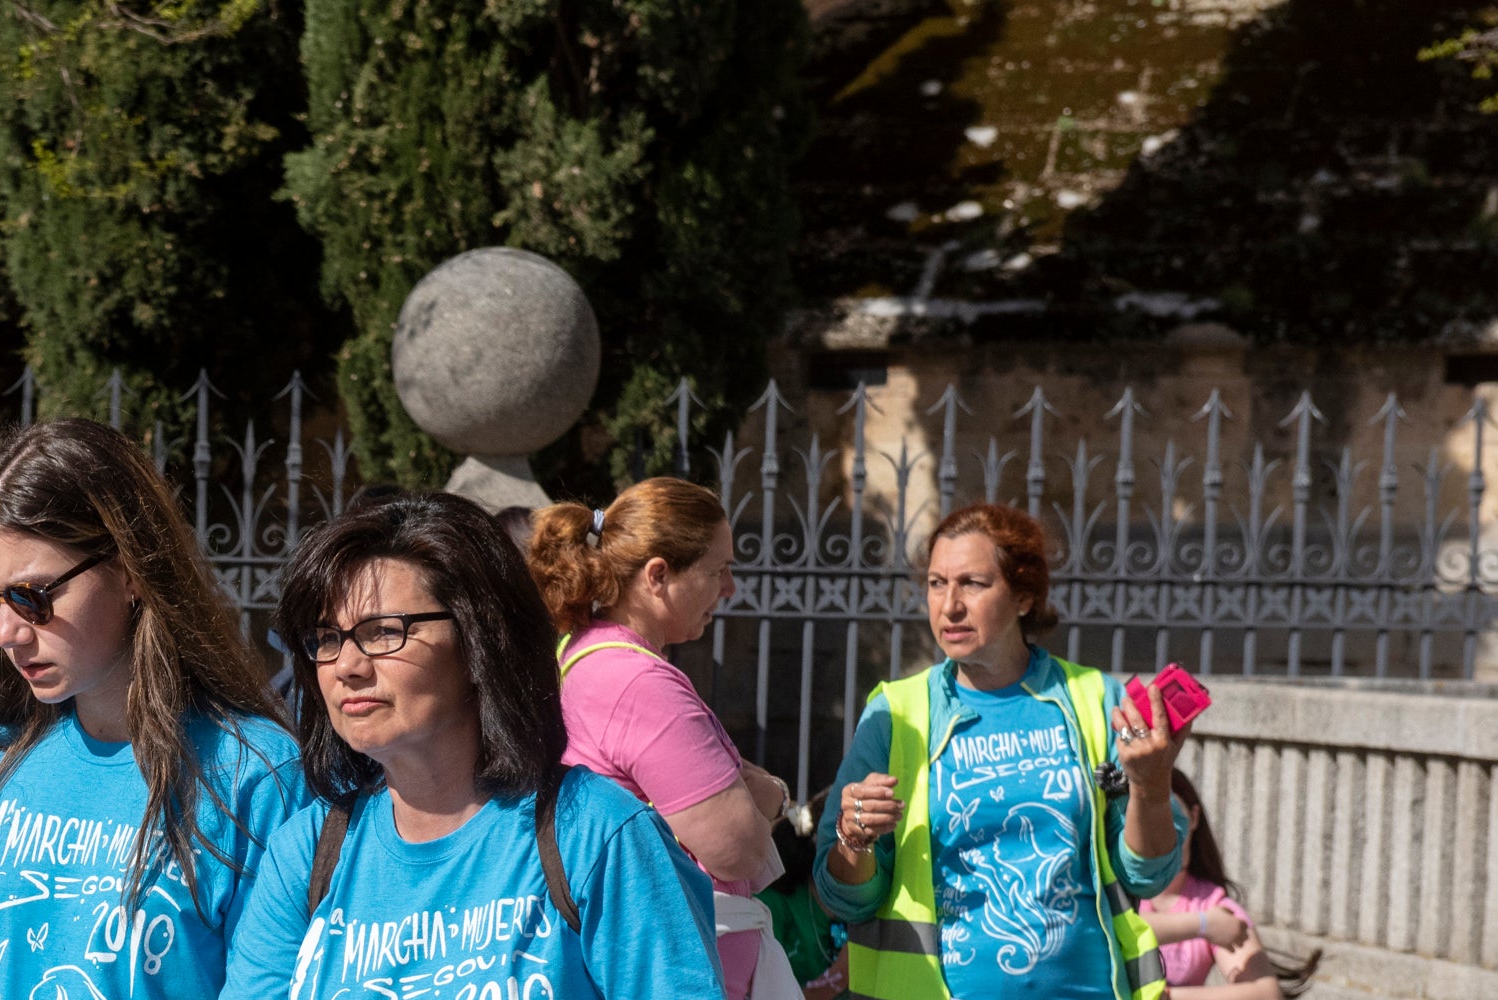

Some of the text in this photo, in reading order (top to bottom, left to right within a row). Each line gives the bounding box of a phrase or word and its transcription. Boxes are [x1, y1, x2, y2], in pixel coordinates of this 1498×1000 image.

[951, 731, 1023, 771] MARCHA
[1028, 725, 1069, 756] MUJE
[951, 755, 1070, 791] SEGOVI
[1039, 766, 1085, 816] 201
[0, 807, 103, 868] MARCHA
[84, 900, 175, 999] 2018
[341, 910, 446, 984] MARCHA
[461, 894, 552, 952] MUJERES
